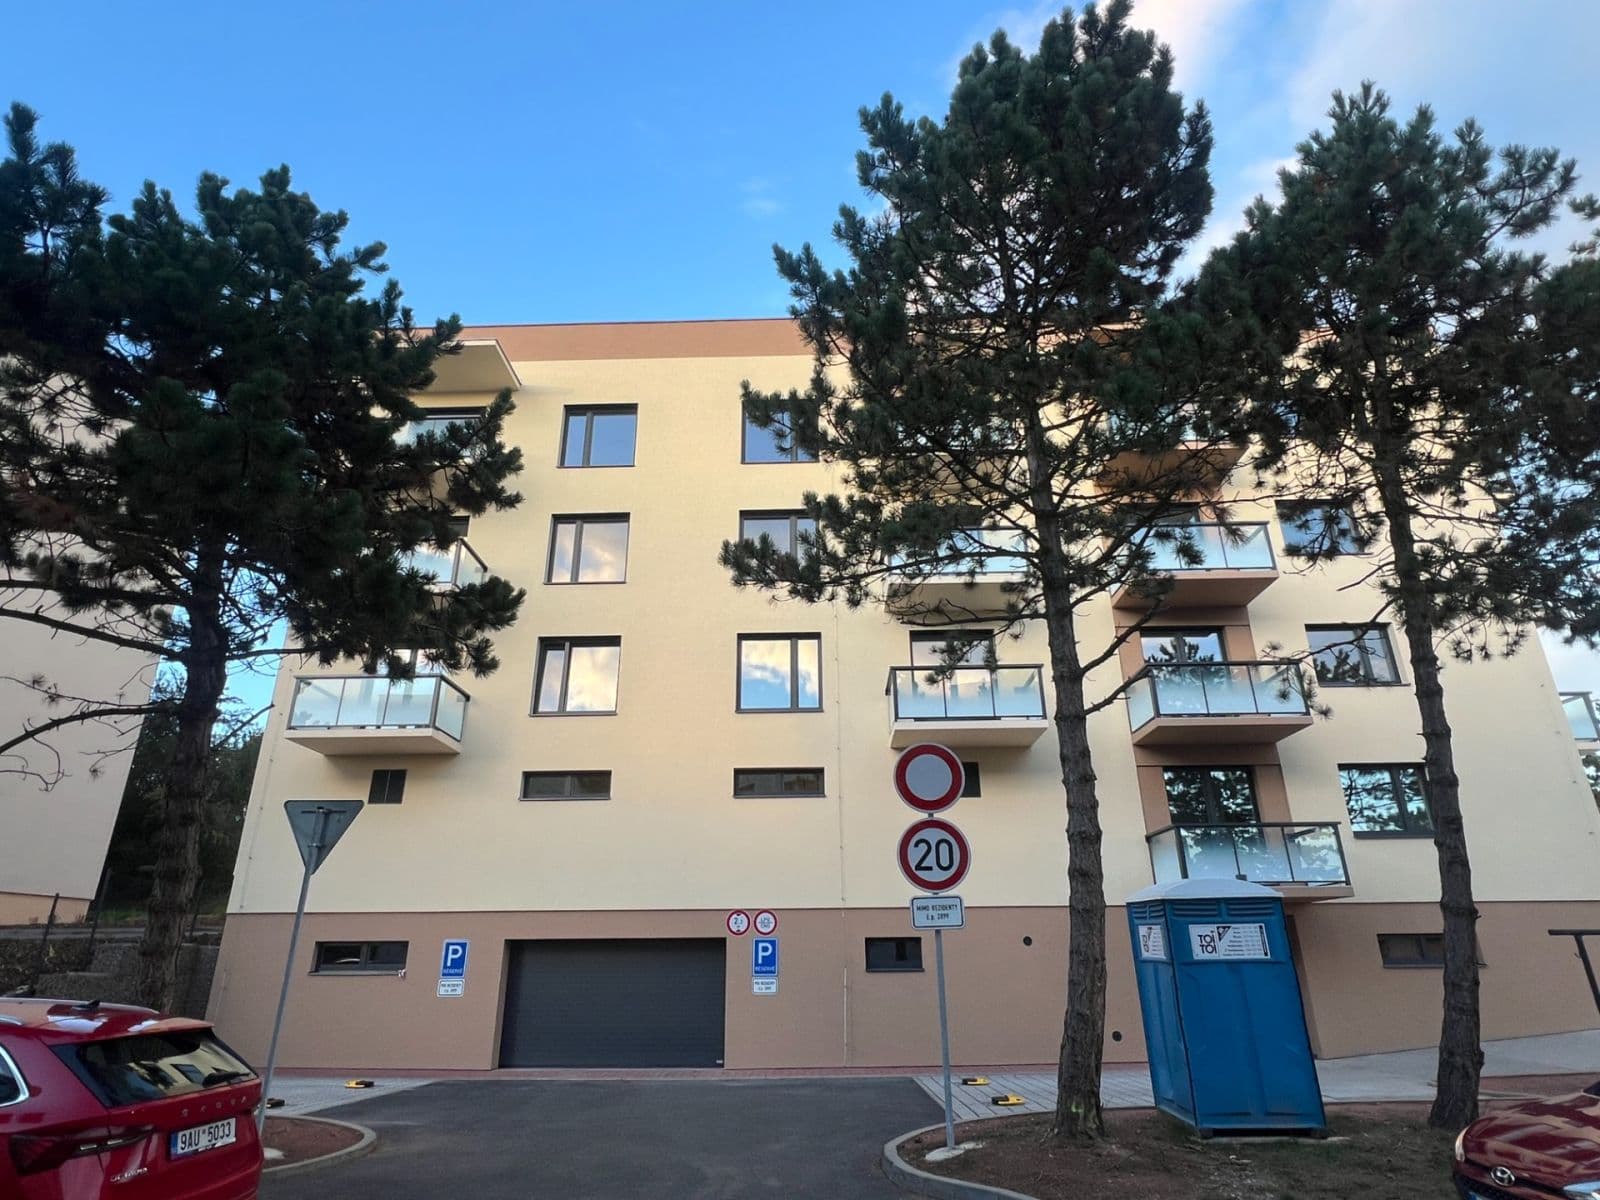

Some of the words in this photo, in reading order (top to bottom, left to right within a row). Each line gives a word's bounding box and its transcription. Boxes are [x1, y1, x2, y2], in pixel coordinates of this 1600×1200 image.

[913, 838, 954, 871] 20
[447, 945, 463, 967] P
[758, 942, 773, 965] P
[180, 1129, 200, 1151] 9AU
[207, 1120, 232, 1143] 5033
